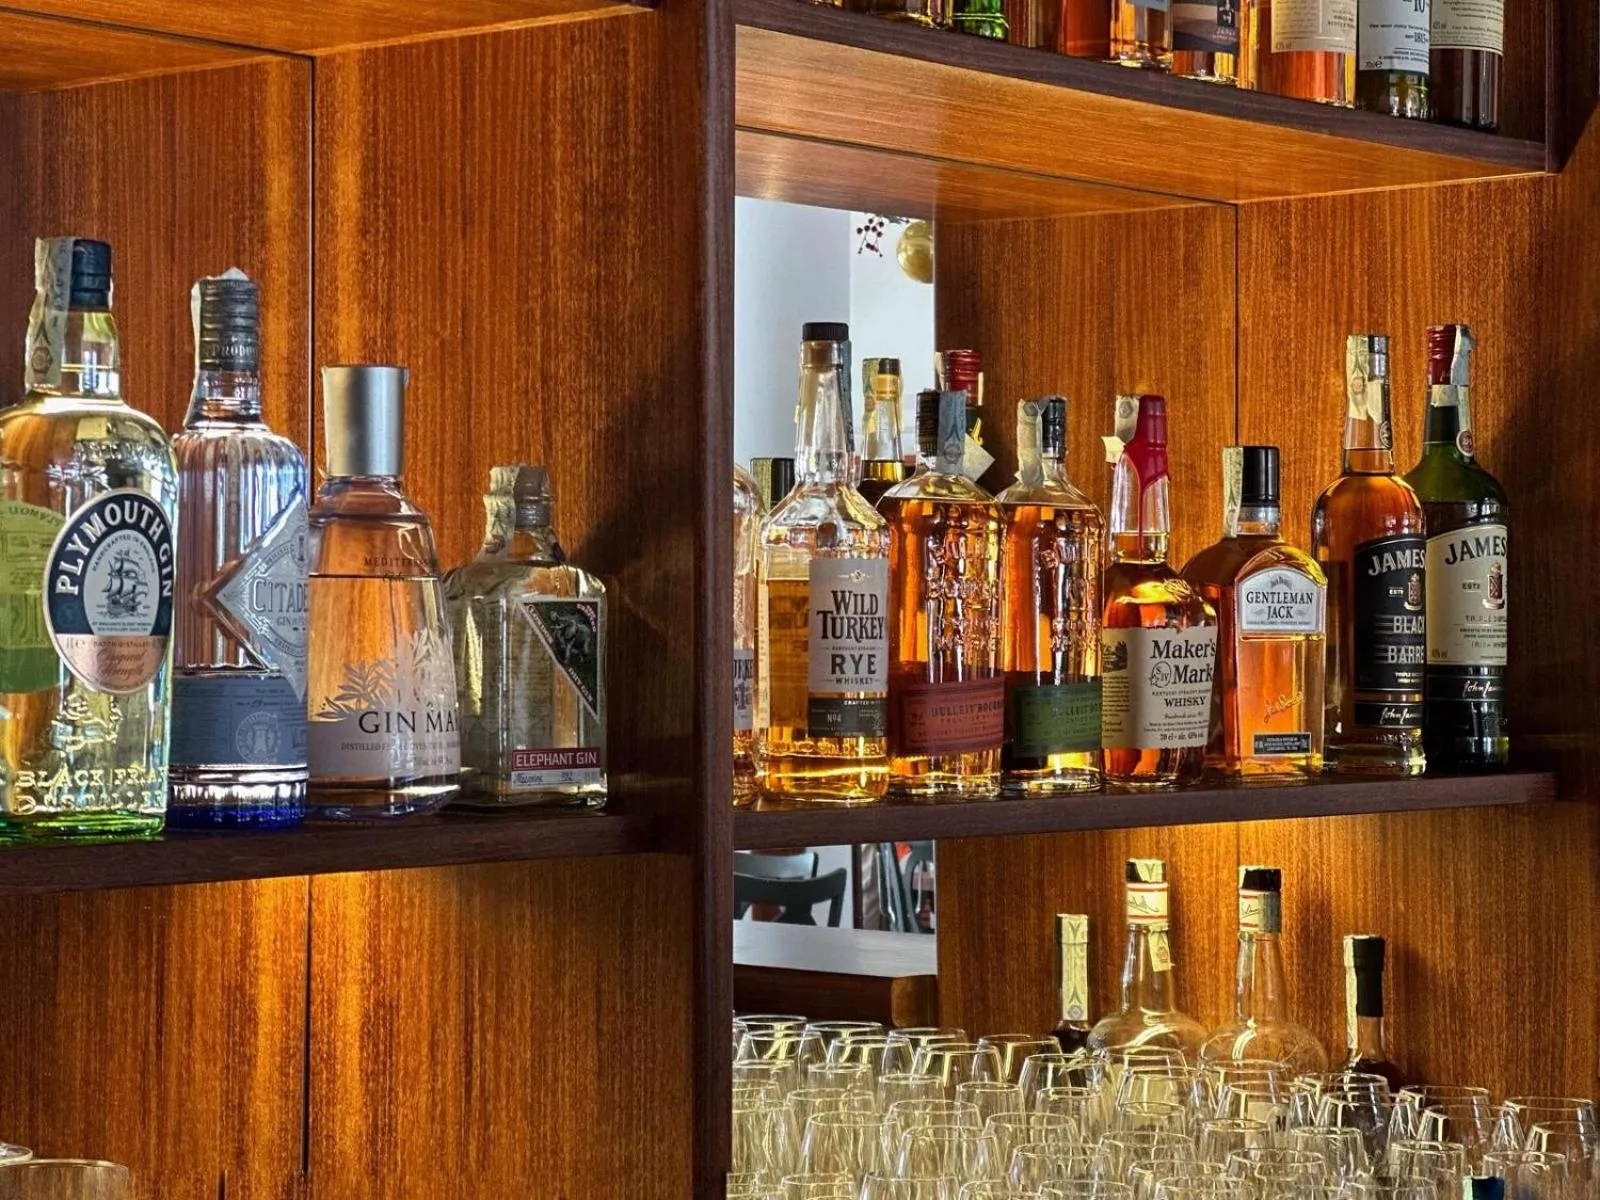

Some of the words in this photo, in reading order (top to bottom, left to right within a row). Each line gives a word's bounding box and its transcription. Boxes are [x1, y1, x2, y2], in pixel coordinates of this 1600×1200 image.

[55, 500, 163, 596] PLYMOUTH
[158, 542, 172, 597] GIN
[1445, 536, 1506, 565] JAMES
[1368, 548, 1425, 576] JAMES
[253, 578, 308, 613] CITADE
[831, 590, 879, 616] WILD
[1246, 591, 1313, 604] GENTLEMAN
[1266, 605, 1294, 620] JACK
[816, 610, 884, 643] TURKEY
[1393, 615, 1424, 634] BLAC
[1149, 638, 1216, 659] Maker's
[1387, 645, 1425, 664] BARRE
[831, 653, 876, 675] RYE
[1171, 663, 1213, 685] Mark
[836, 677, 873, 685] WHISKEY
[1164, 696, 1206, 707] WHISKY
[358, 711, 416, 734] GIN
[516, 753, 574, 767] ELEPHANT
[576, 752, 597, 765] GIN
[15, 769, 104, 787] BLACK
